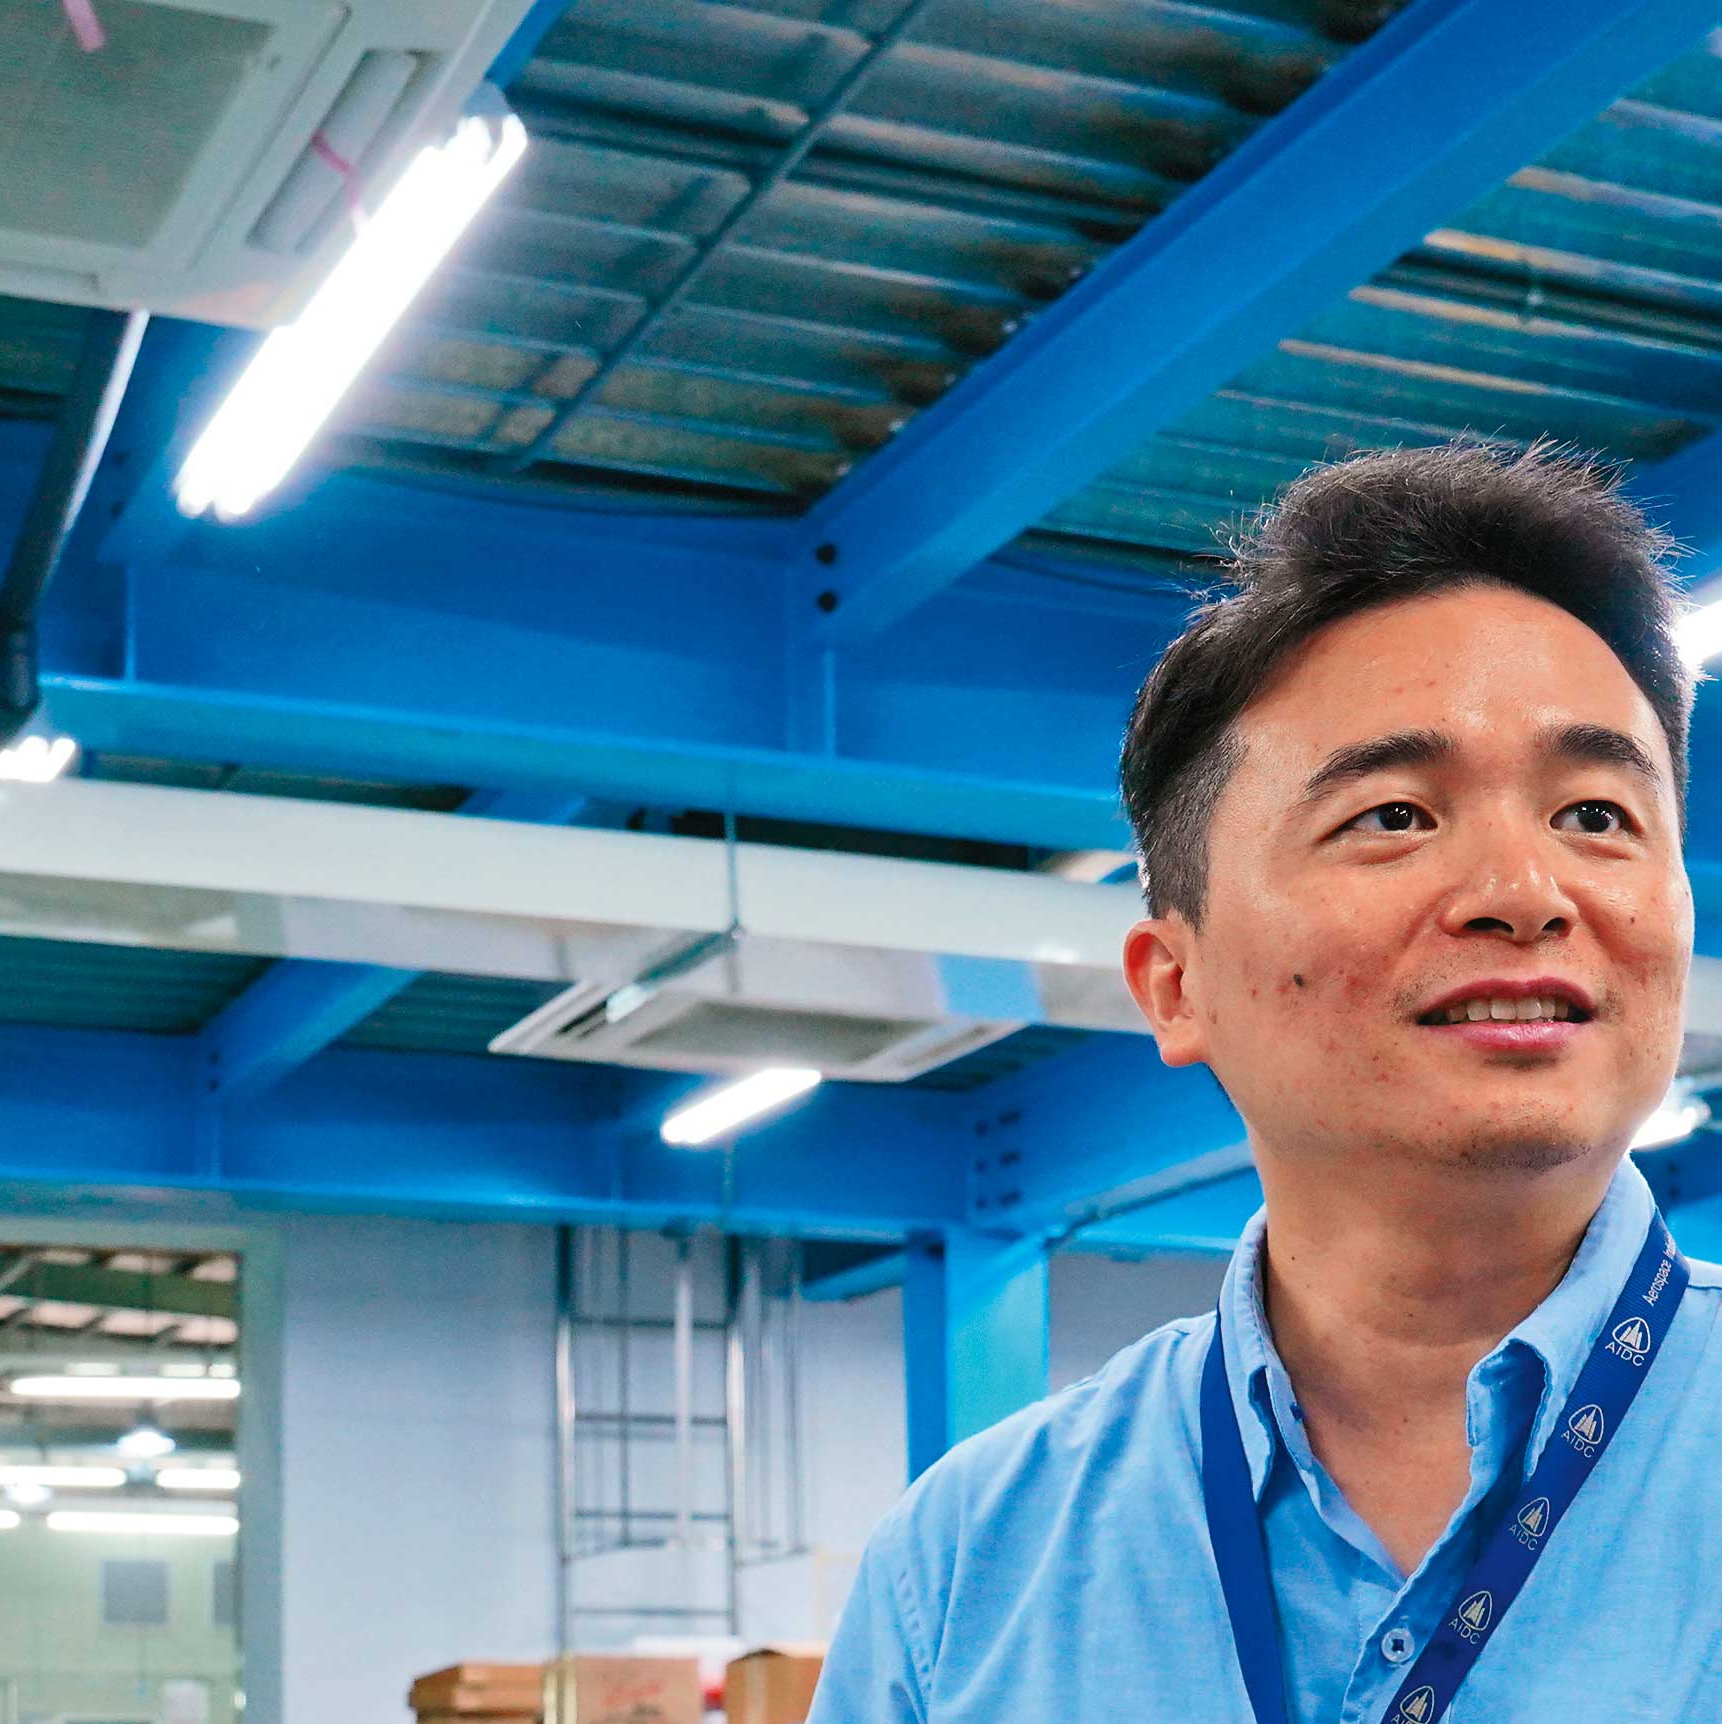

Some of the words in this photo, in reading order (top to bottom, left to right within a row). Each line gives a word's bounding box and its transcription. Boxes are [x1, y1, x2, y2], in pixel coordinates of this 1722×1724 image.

[1642, 1259, 1672, 1307] Aerospace
[1605, 1341, 1645, 1366] AIDC
[1560, 1430, 1595, 1458] AIDC
[1508, 1524, 1538, 1550] AIDC
[1448, 1617, 1480, 1645] AIDC
